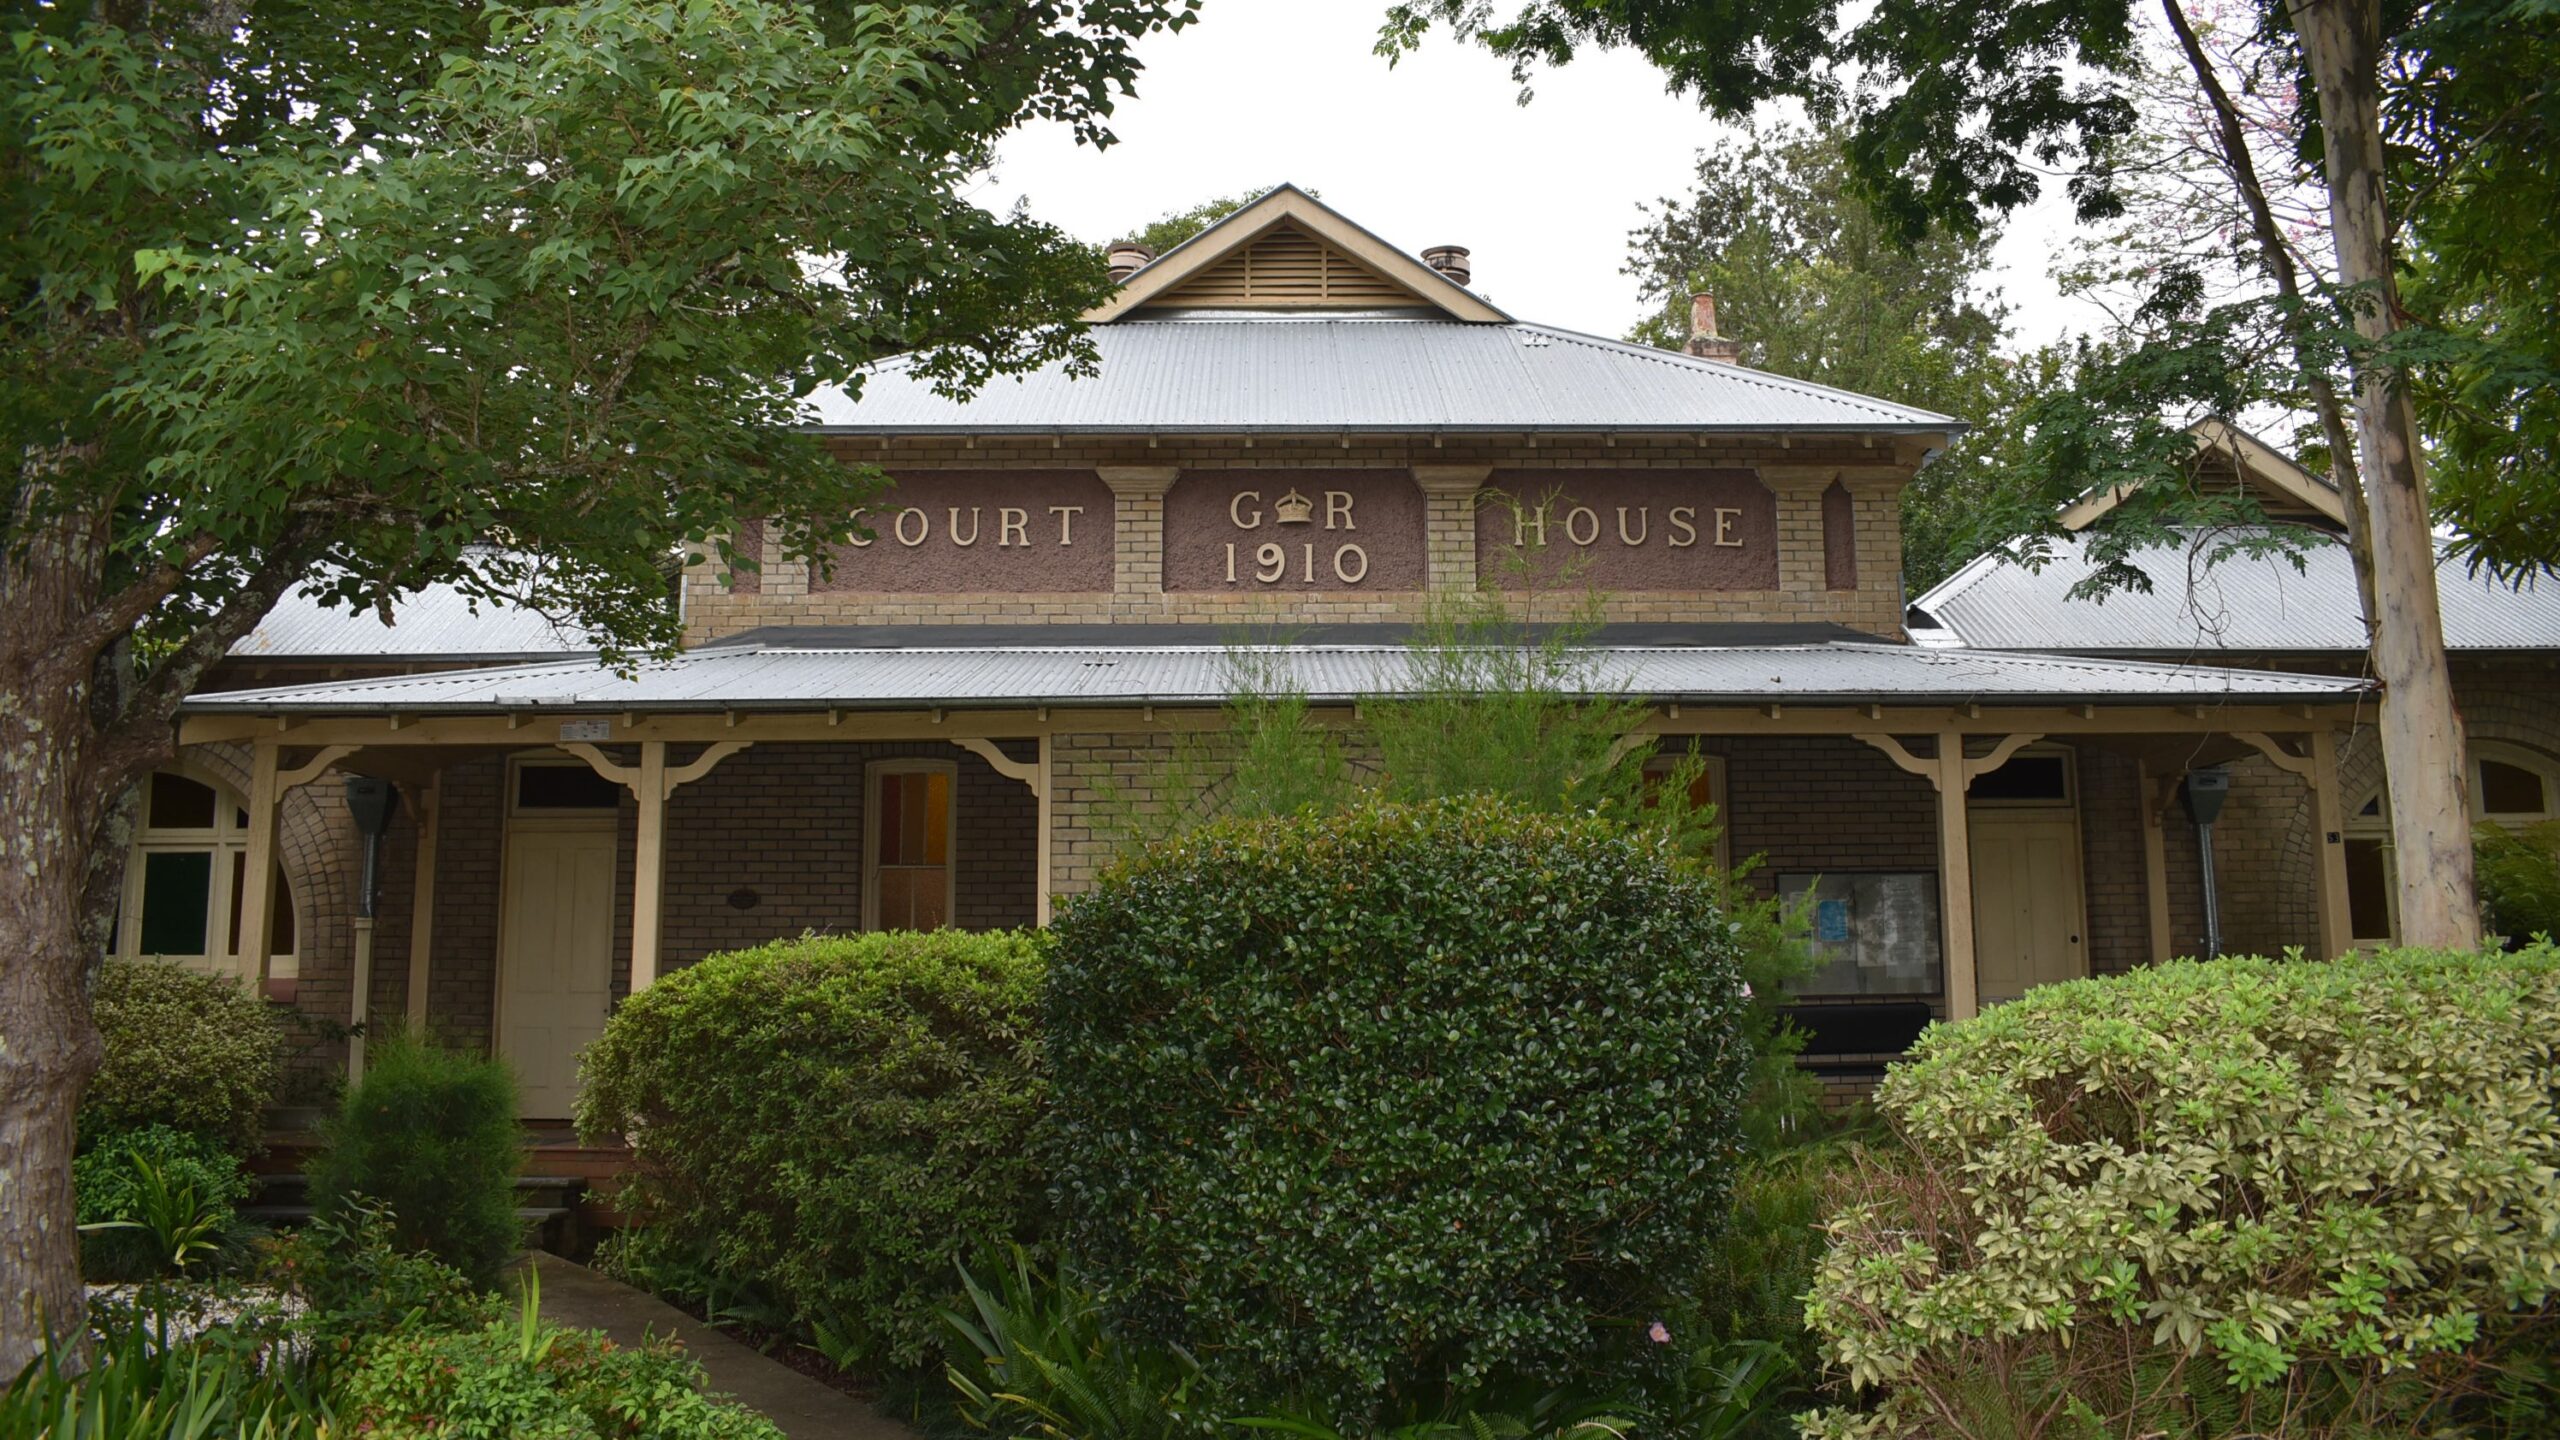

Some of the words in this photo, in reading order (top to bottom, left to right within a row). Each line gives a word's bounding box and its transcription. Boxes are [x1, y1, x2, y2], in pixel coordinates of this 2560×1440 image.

[1230, 491, 1263, 530] G
[1324, 491, 1356, 530] R
[1513, 506, 1743, 547] HOUSE
[1225, 542, 1368, 584] 1910
